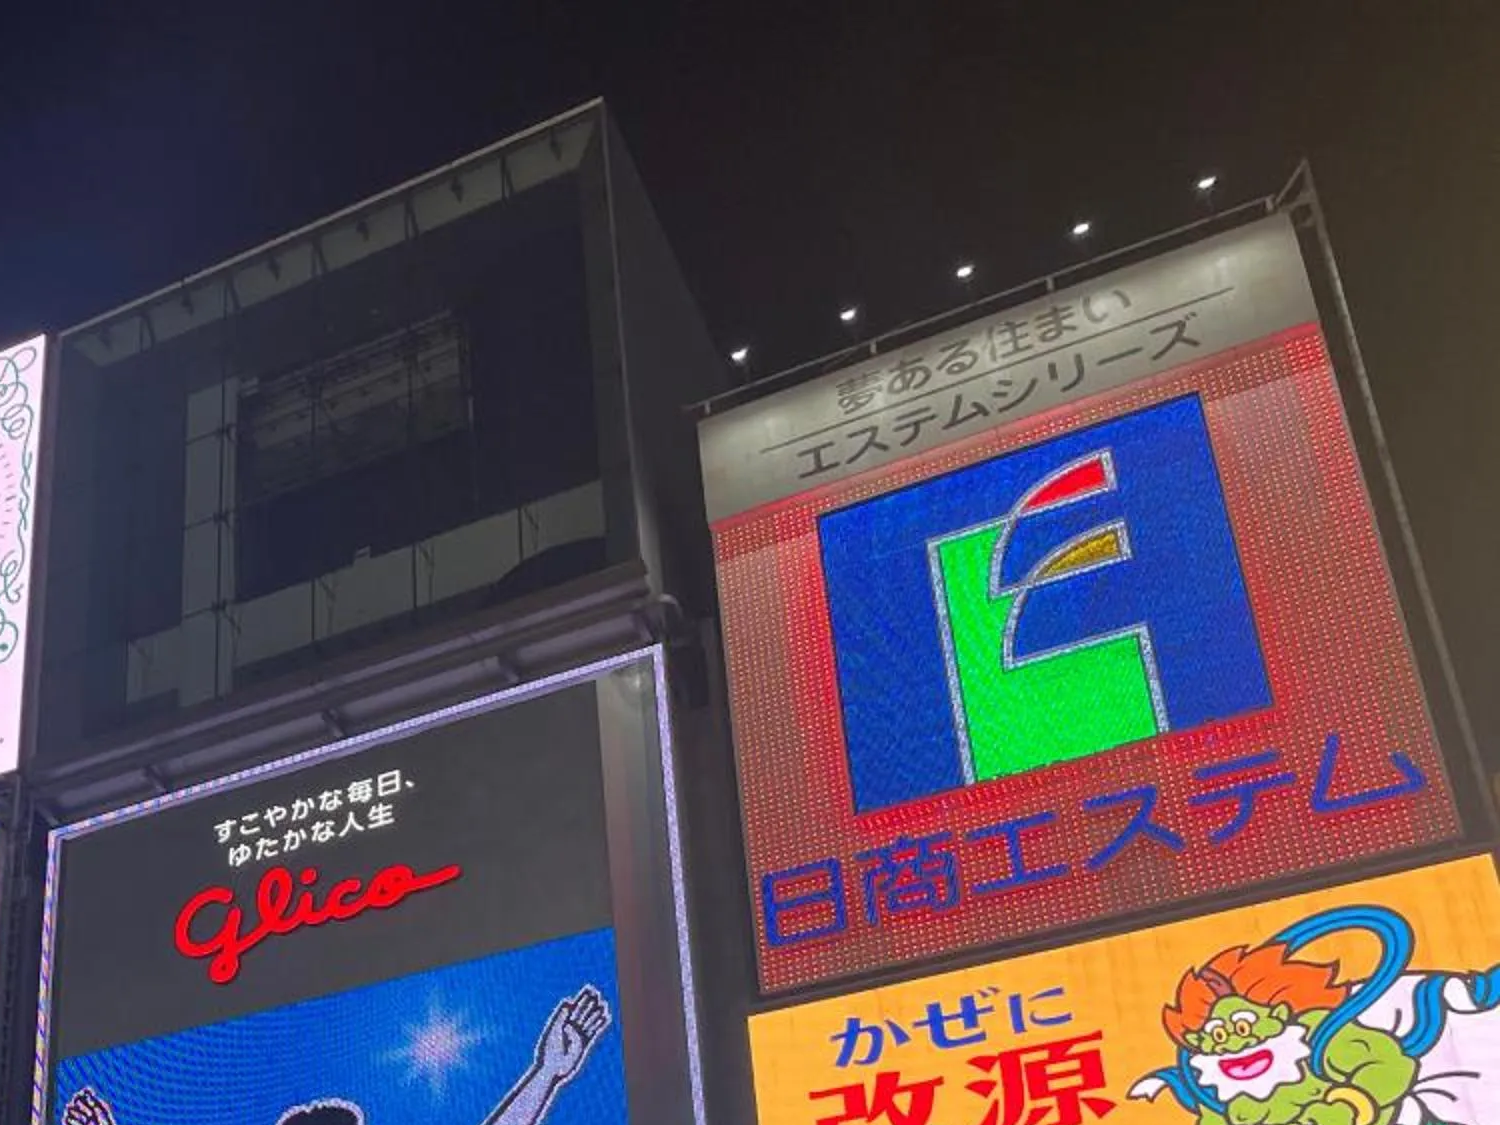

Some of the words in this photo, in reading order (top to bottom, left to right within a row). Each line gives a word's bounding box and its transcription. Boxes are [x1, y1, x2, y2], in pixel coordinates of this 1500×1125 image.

[798, 311, 1200, 479] エステムシリーズ
[835, 288, 1131, 416] 夢ある住まい
[213, 768, 416, 845] すこやかな毎日、
[228, 802, 396, 868] ゆたかな人生
[761, 733, 1426, 948] 日商エステム
[831, 986, 1073, 1068] かぜに
